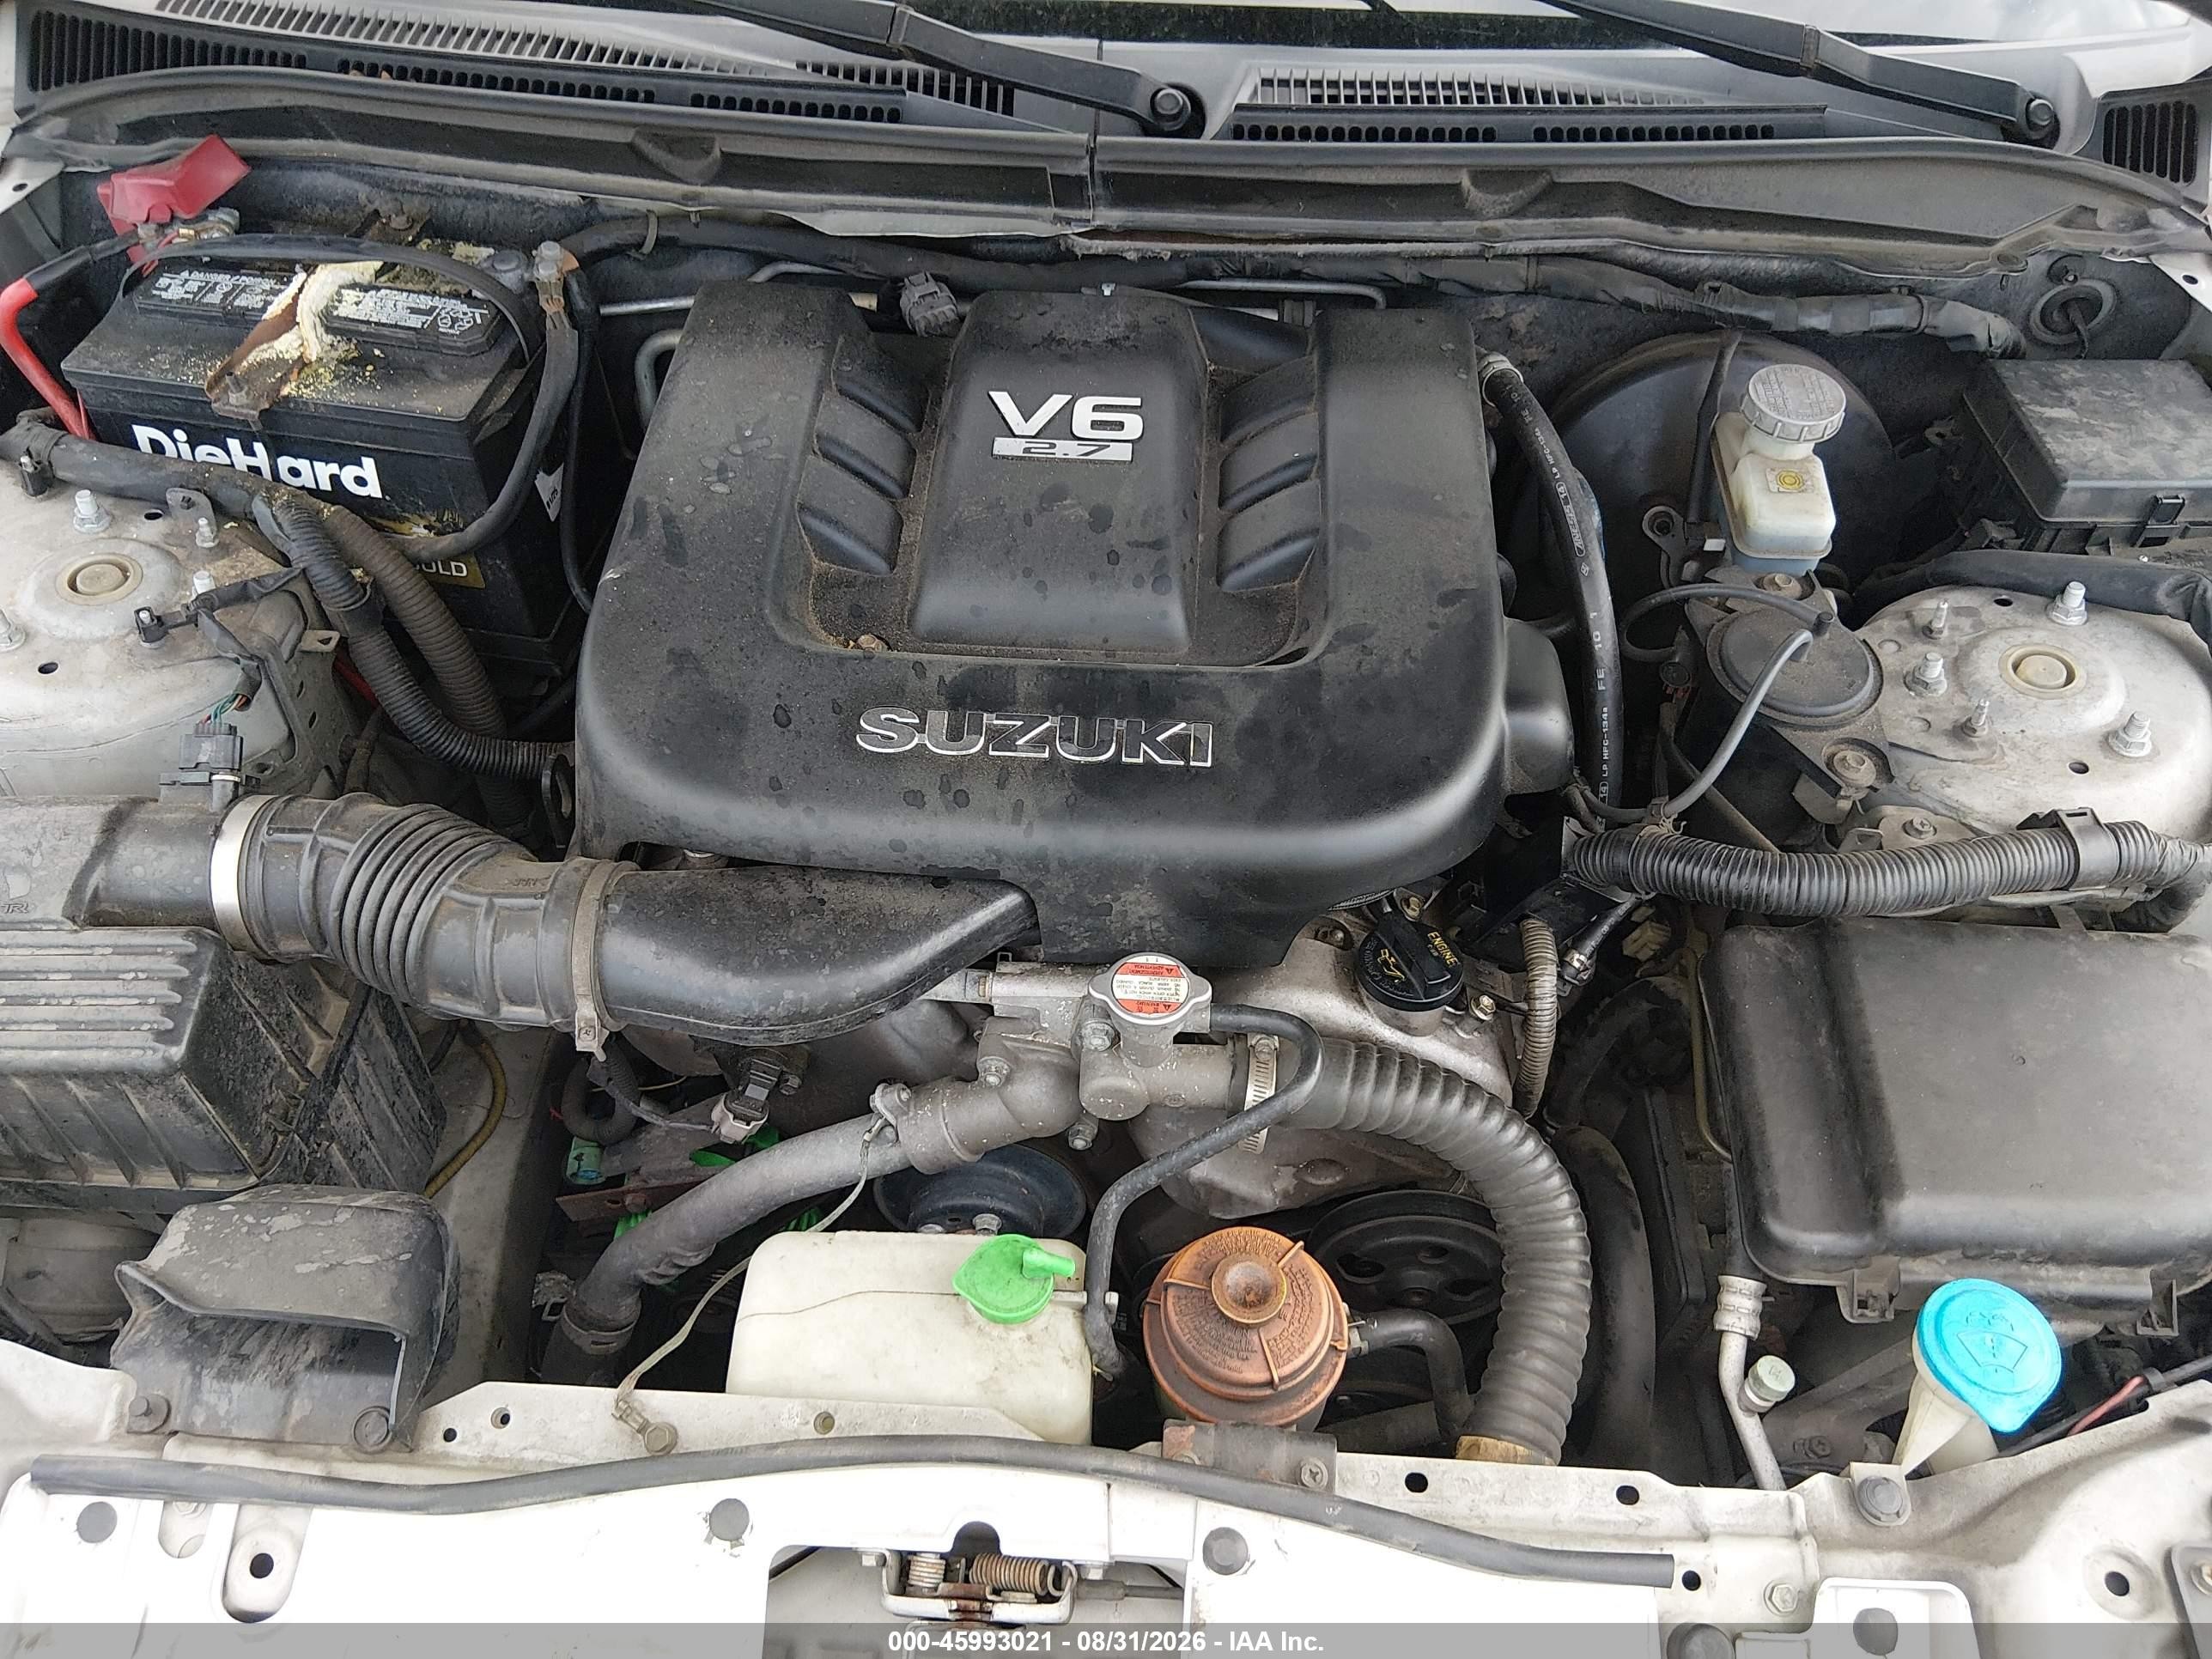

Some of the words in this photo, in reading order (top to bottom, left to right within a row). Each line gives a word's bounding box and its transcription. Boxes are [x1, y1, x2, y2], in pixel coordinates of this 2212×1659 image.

[988, 391, 1144, 441] V6
[131, 424, 383, 498] DieHard
[1021, 441, 1112, 459] 2.7
[412, 559, 468, 577] OLD
[855, 706, 1213, 768] SUZUKI
[1602, 764, 1608, 776] LP
[1427, 931, 1459, 966] ENGINE
